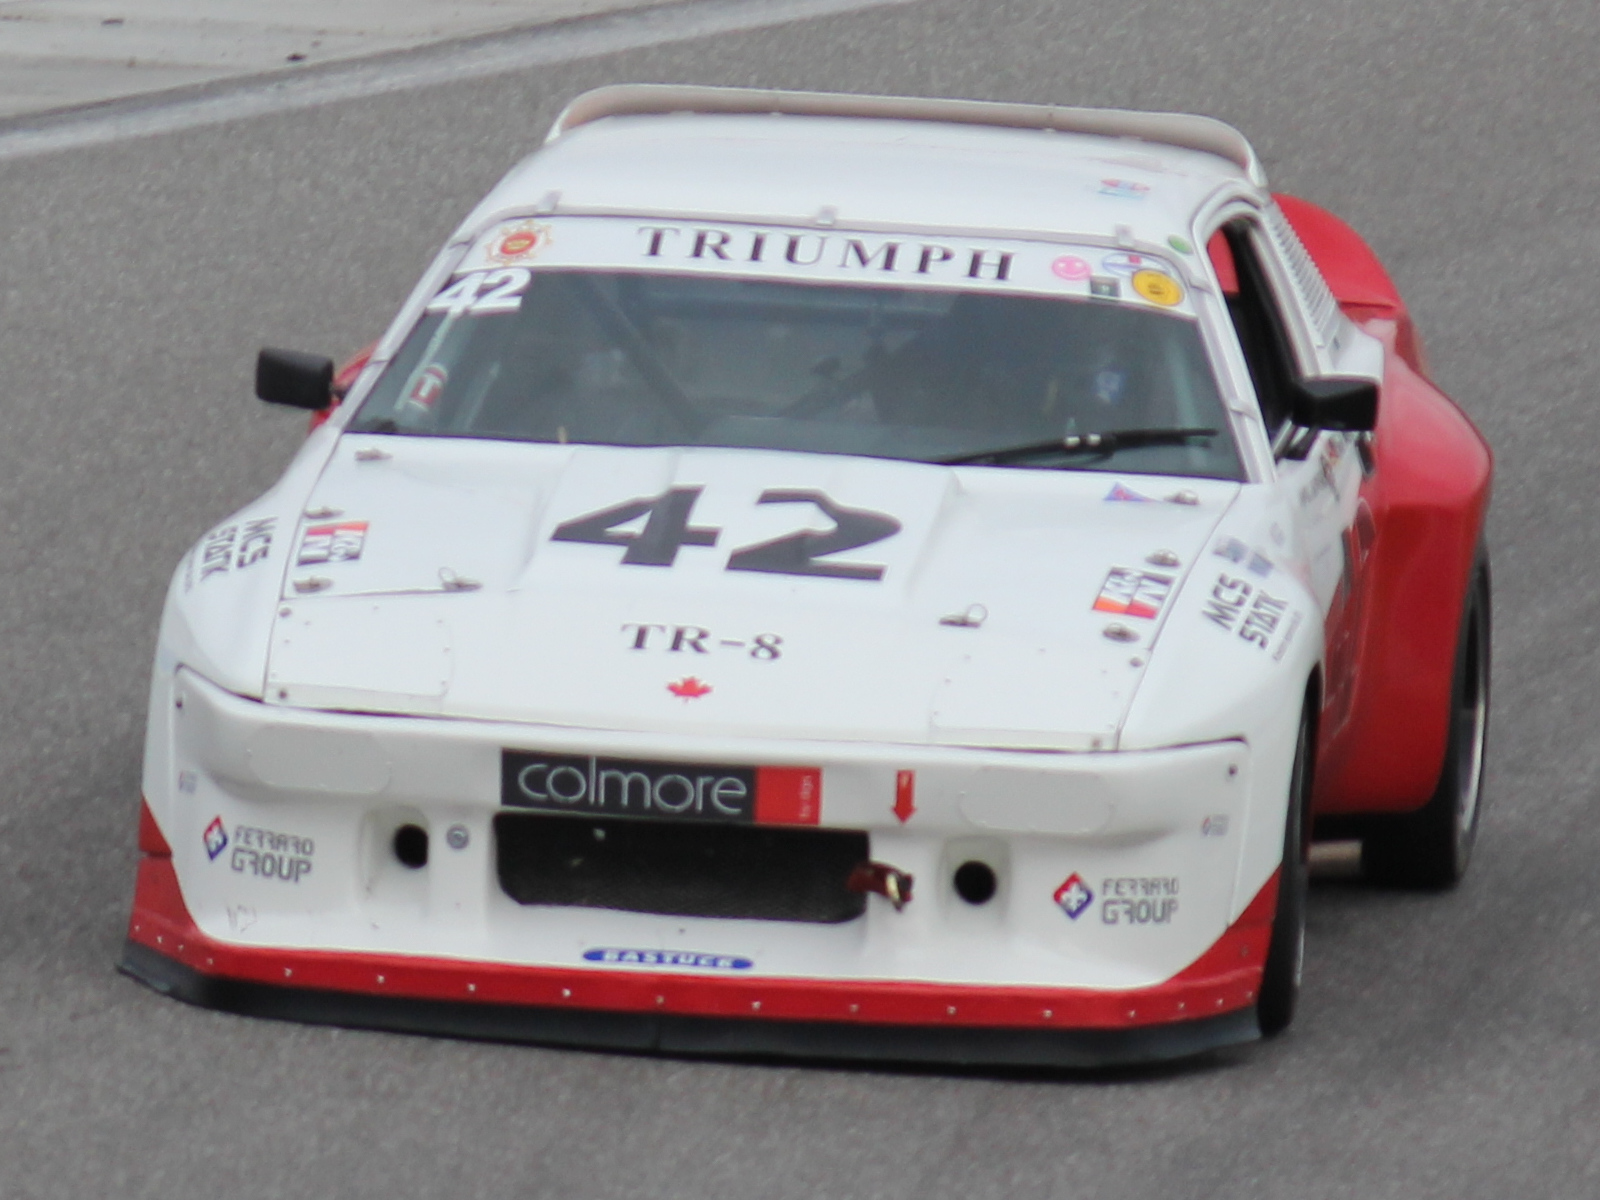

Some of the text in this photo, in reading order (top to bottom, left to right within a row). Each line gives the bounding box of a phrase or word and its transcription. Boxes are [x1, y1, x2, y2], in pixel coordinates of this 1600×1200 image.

[637, 225, 1018, 281] TRIUMPH
[427, 267, 531, 318] 42
[236, 516, 279, 569] MCS
[549, 484, 903, 581] 42
[1202, 573, 1253, 632] MCS
[620, 623, 785, 660] TR-8
[518, 756, 747, 815] colmore
[231, 848, 312, 883] GROUP
[1102, 900, 1180, 926] GROUP
[603, 951, 734, 968] BASTUCK
